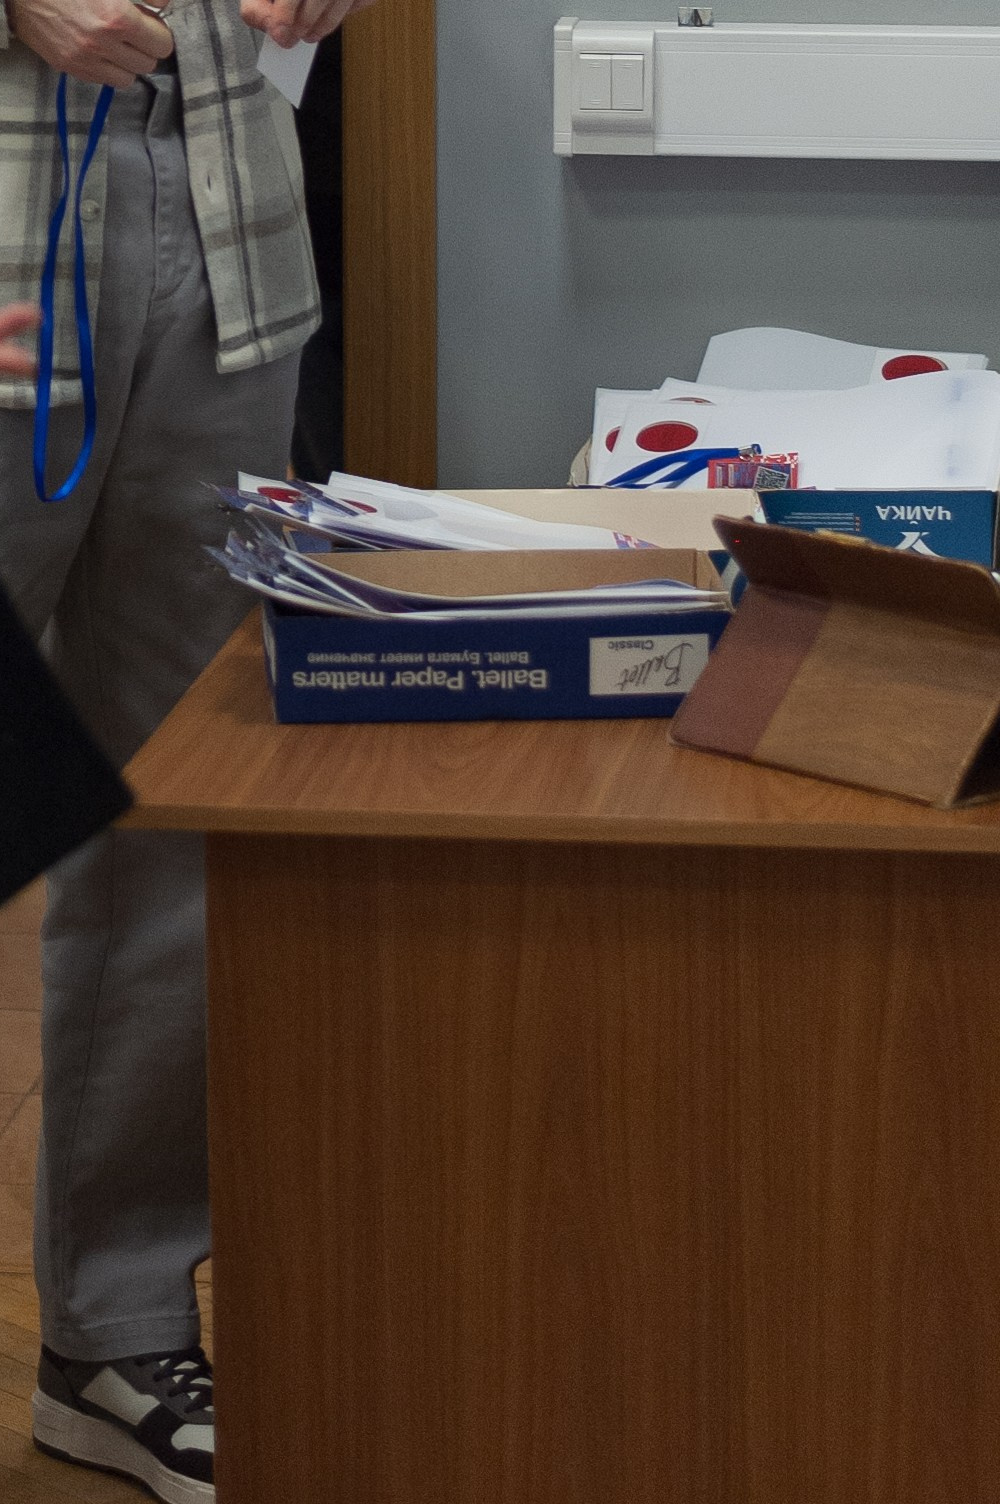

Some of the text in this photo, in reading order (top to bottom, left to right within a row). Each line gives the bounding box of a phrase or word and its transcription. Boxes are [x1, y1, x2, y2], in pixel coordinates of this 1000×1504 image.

[875, 505, 952, 525] ЧАЙКА
[608, 640, 653, 652] Classic
[307, 650, 529, 664] Ballet. Бумага имеет значение
[616, 643, 694, 691] Ballet
[292, 666, 547, 691] Ballet. Paper matters
